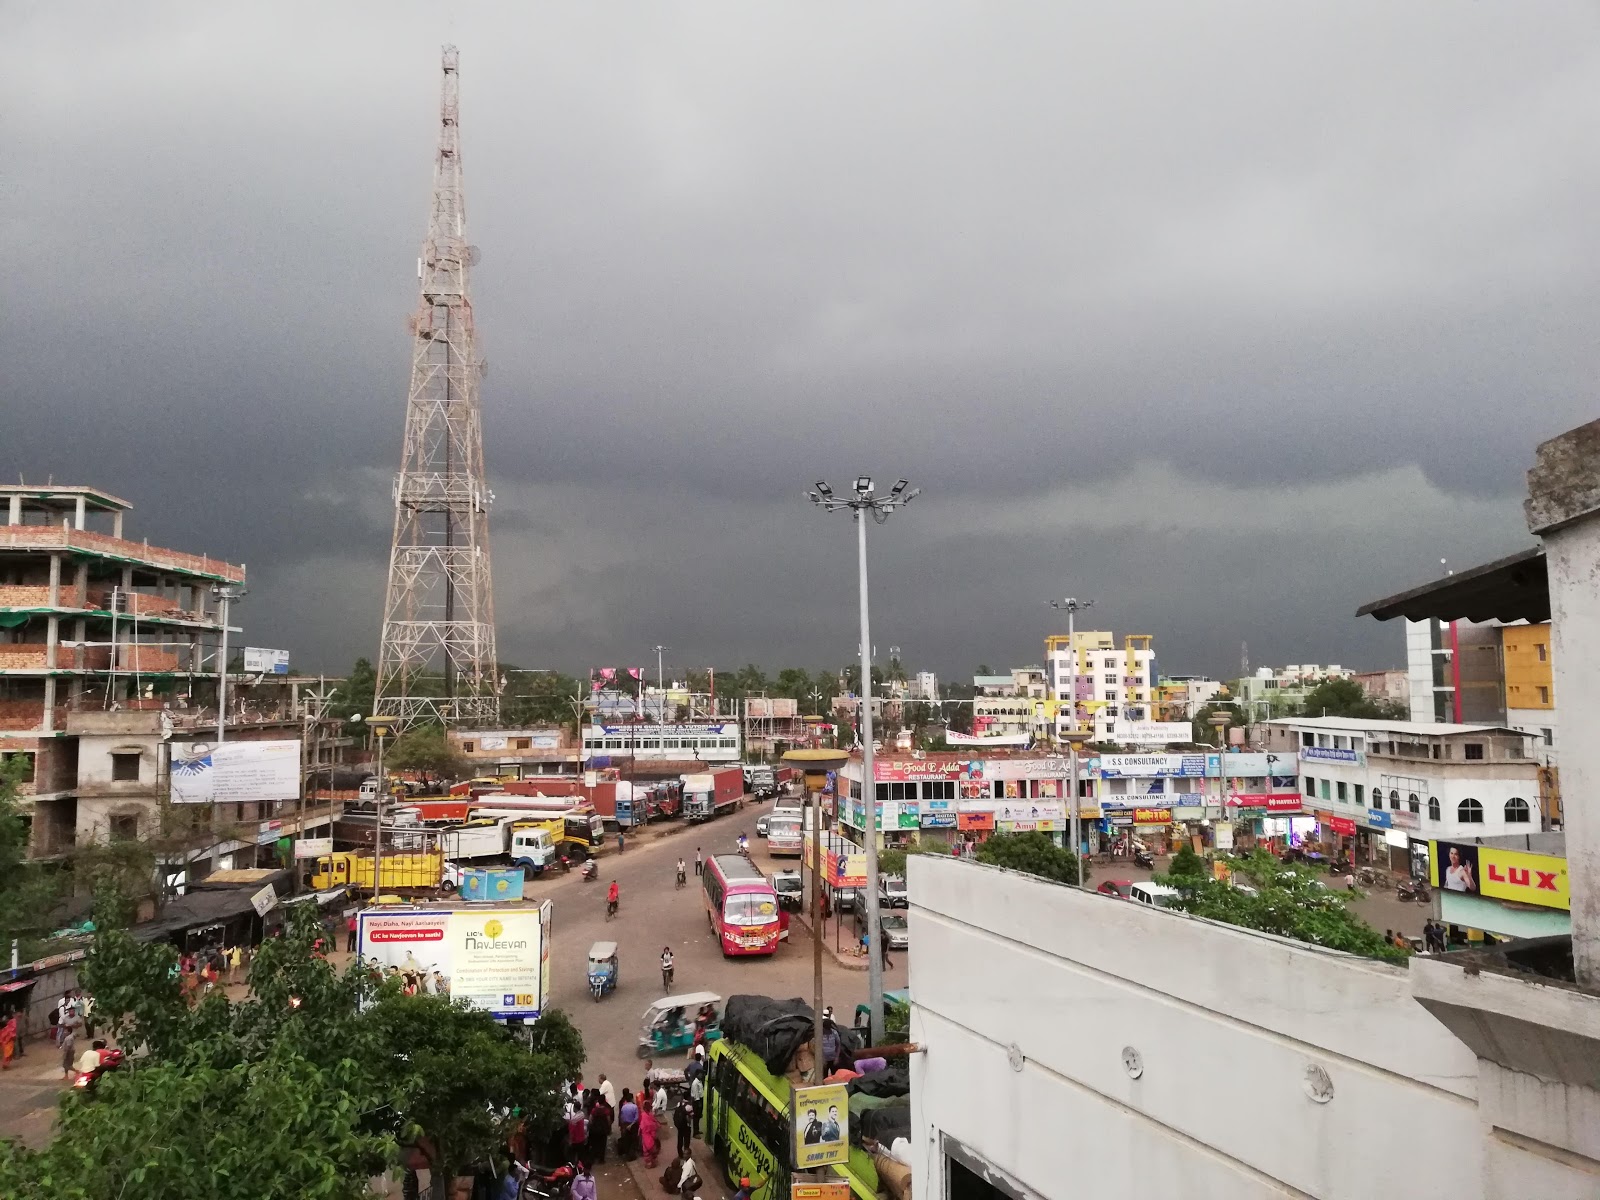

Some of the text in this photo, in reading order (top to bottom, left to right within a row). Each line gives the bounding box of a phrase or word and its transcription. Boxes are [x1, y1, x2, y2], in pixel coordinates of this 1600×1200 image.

[1124, 757, 1168, 766] CONSULTANCY
[903, 761, 960, 775] Food E Adda
[1024, 761, 1046, 774] Food
[1048, 761, 1057, 772] E
[1368, 813, 1382, 822] vivo
[1014, 822, 1037, 830] Amul
[1487, 863, 1559, 892] LUX
[519, 966, 535, 974] Savings
[517, 995, 532, 1005] LIC
[739, 1124, 770, 1175] Surya
[826, 1150, 839, 1159] TMT
